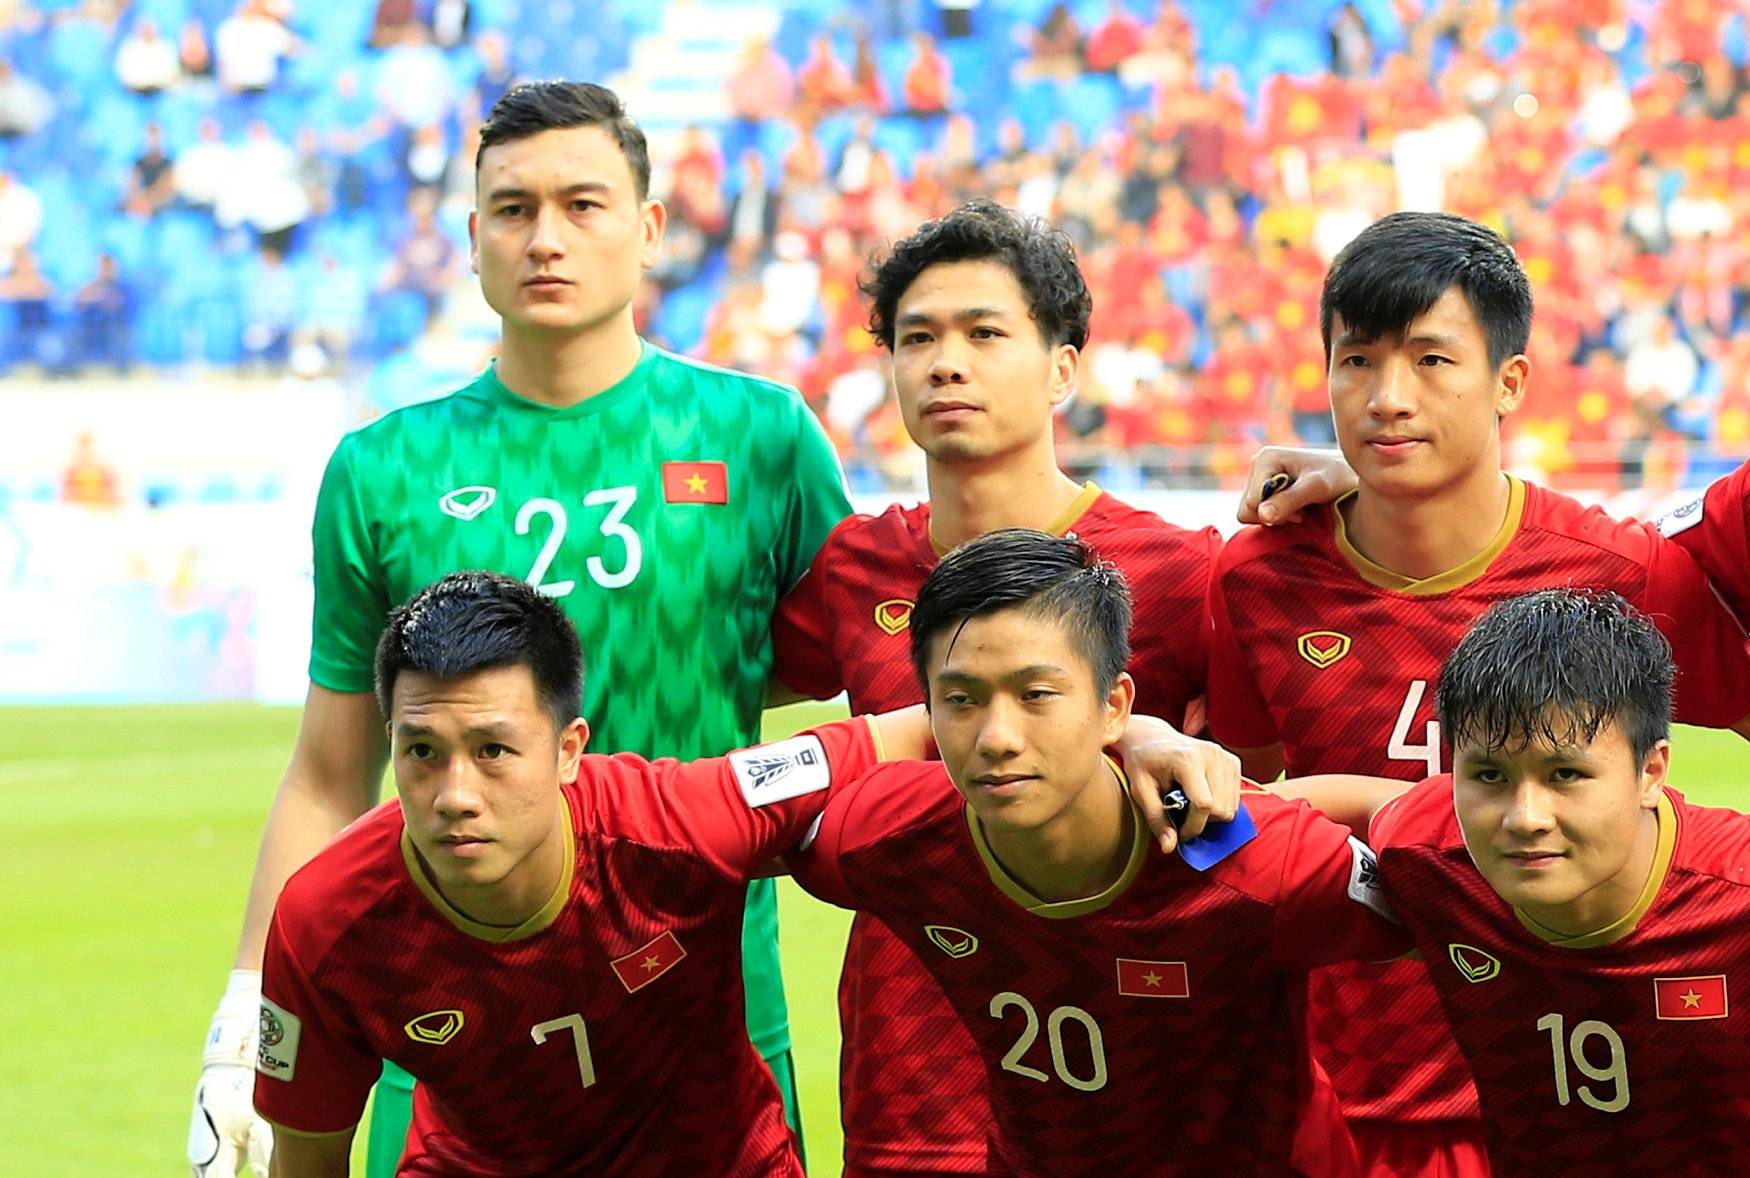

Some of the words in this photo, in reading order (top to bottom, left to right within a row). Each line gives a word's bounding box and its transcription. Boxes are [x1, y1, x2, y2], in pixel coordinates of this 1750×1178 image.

[514, 485, 643, 598] 23
[1387, 680, 1441, 778] 4
[531, 1013, 596, 1089] 7
[989, 992, 1108, 1092] 20
[1537, 1013, 1631, 1114] 19
